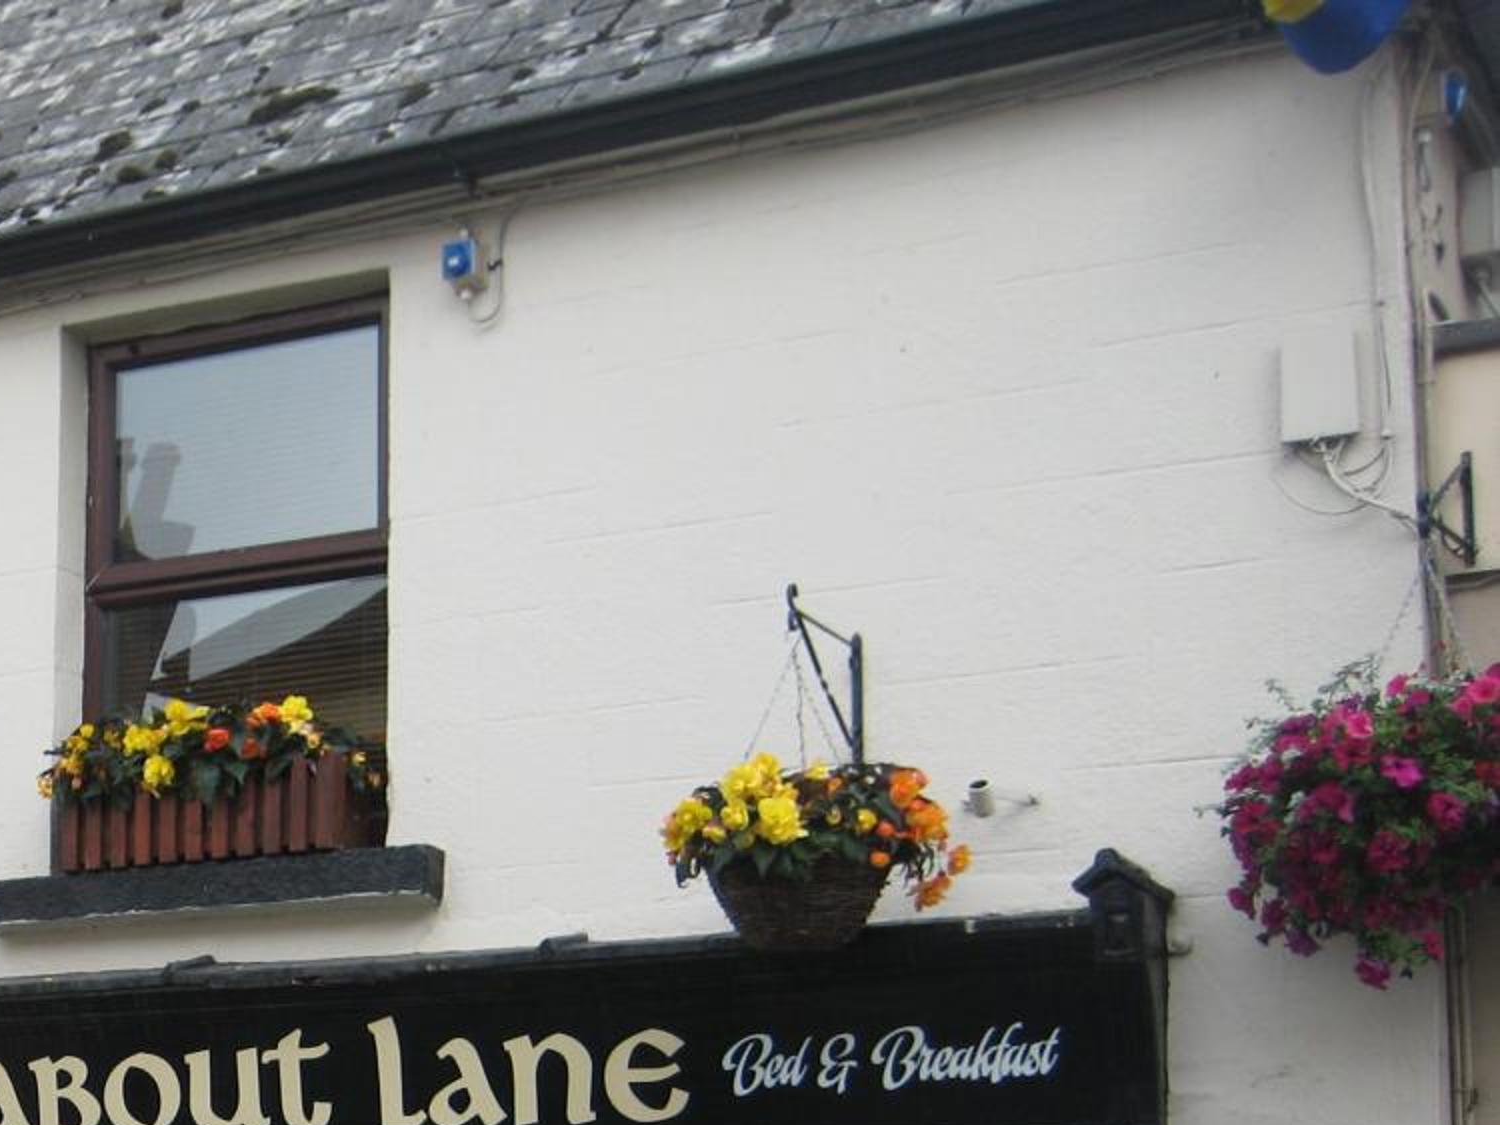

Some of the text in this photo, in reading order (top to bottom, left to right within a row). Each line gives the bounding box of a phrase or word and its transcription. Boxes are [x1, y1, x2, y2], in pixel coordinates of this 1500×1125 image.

[722, 1023, 1059, 1096] Bed & Breakfast
